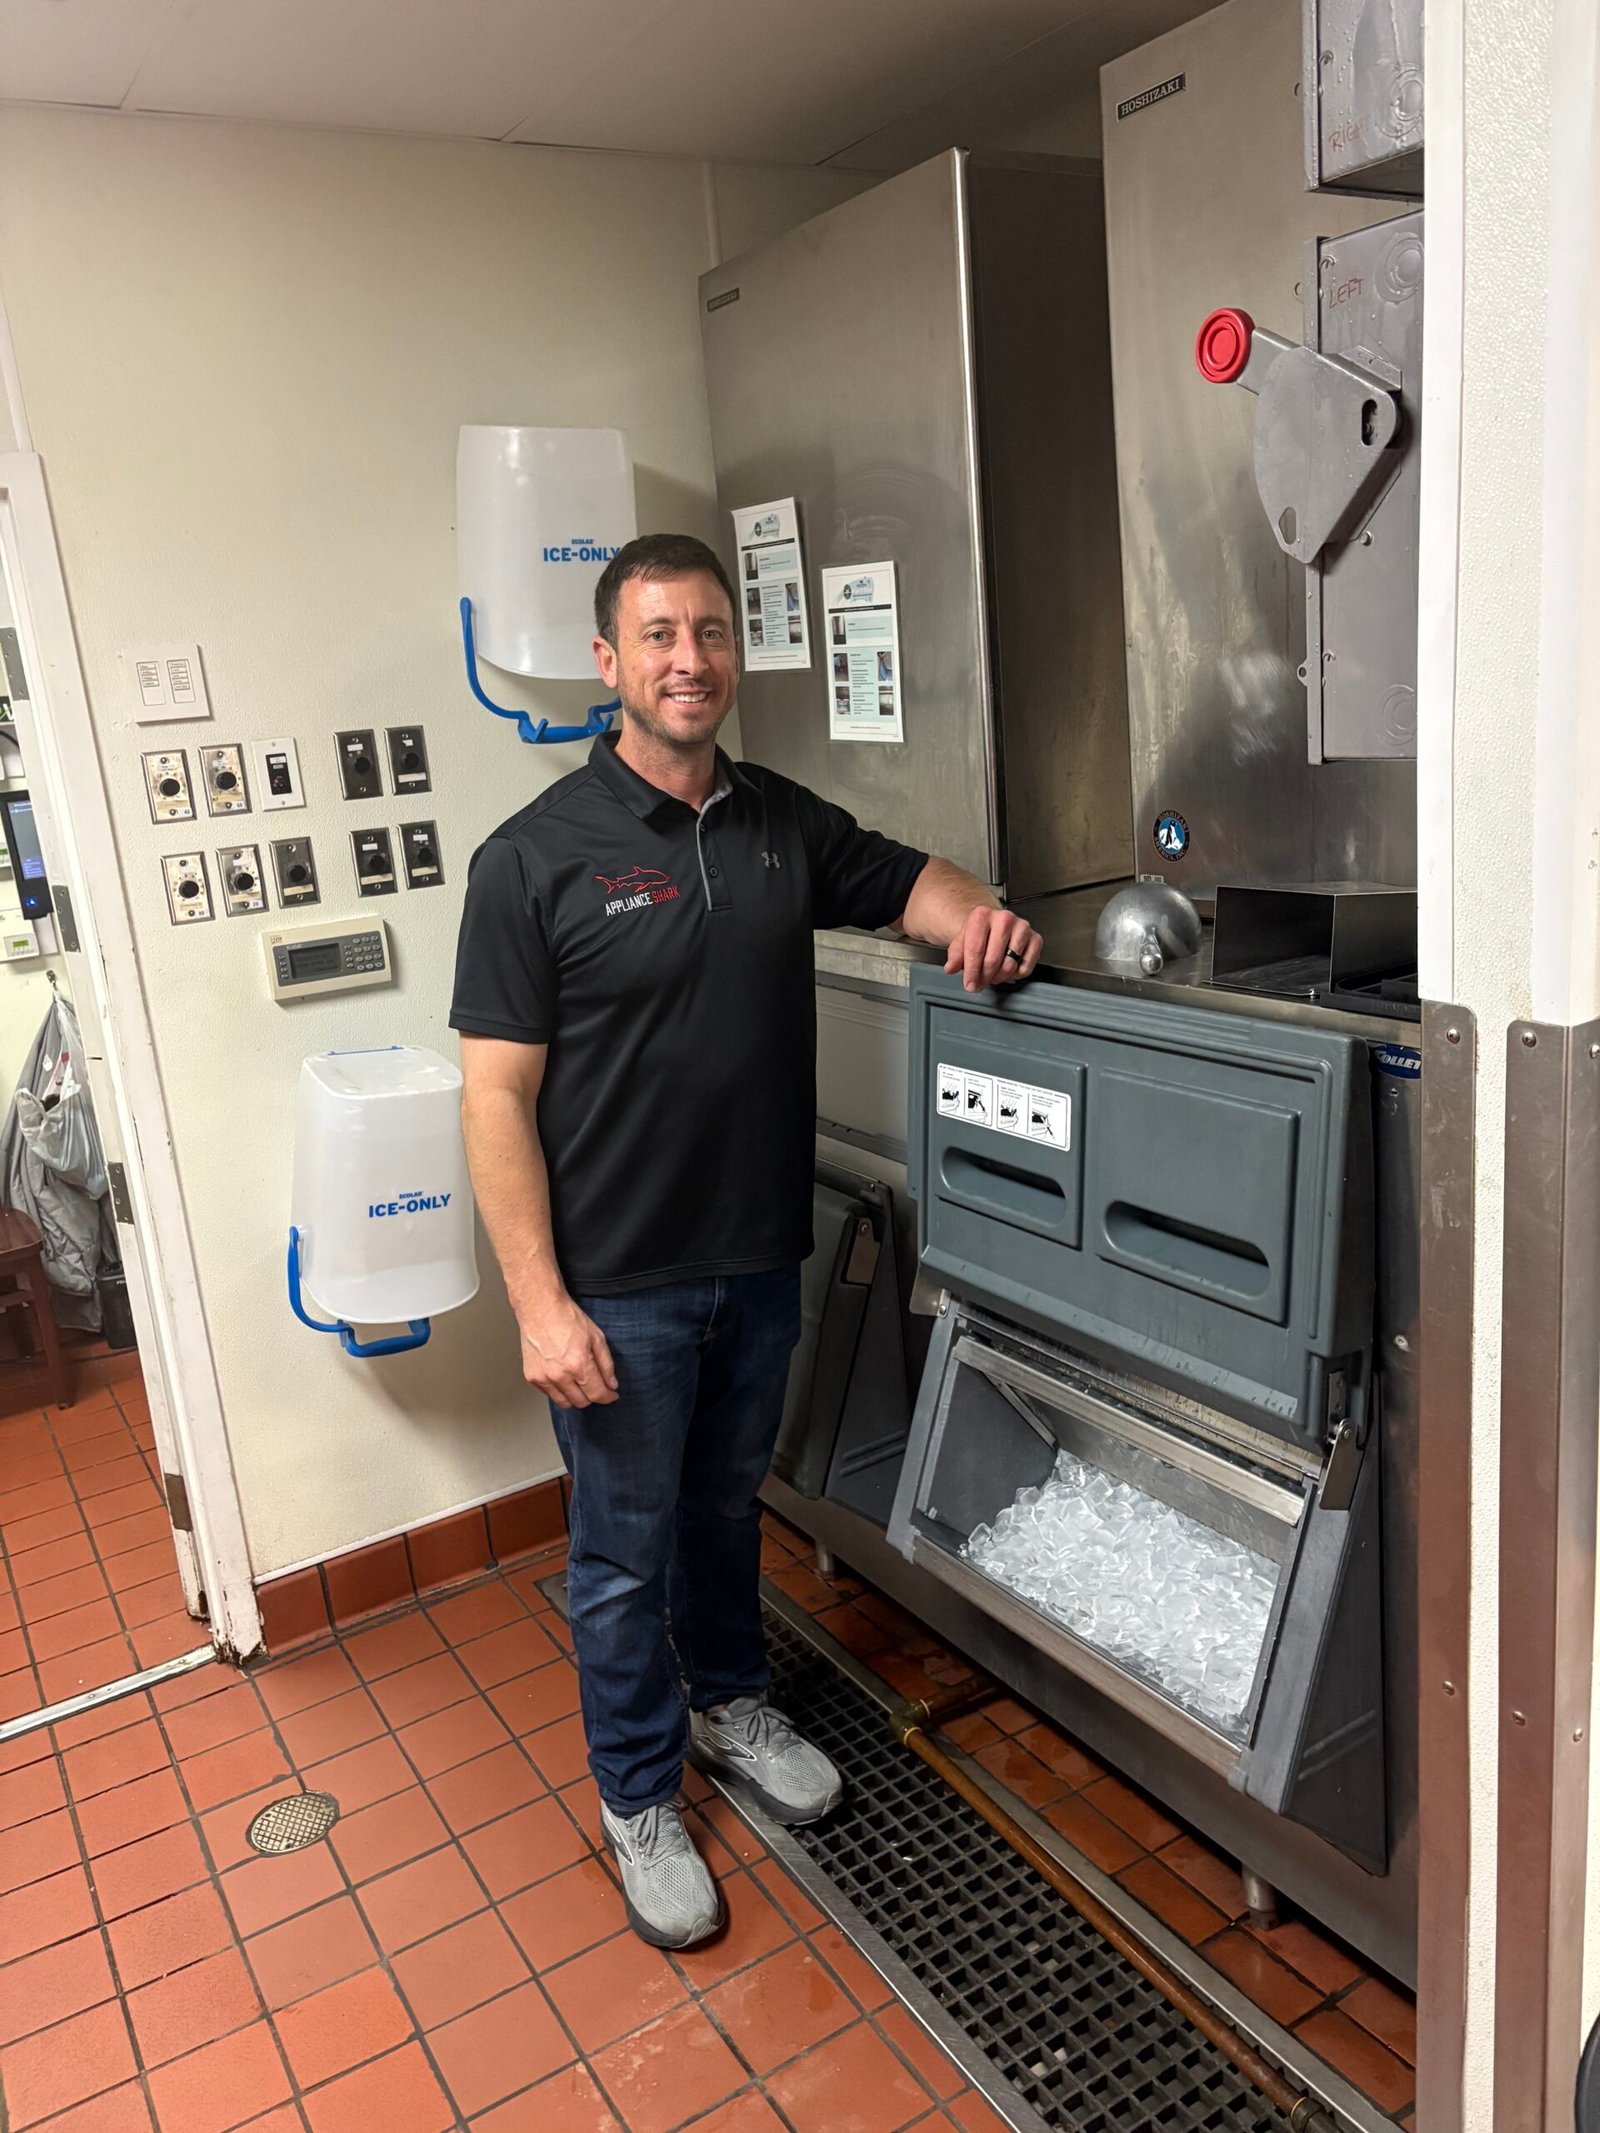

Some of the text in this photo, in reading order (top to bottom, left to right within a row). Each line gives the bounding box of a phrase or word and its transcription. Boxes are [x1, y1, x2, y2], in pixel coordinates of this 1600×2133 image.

[1120, 78, 1181, 116] HOSHIZAKI
[1328, 278, 1364, 310] LEFT
[543, 547, 620, 562] ICE-ONLY
[605, 886, 680, 917] APPLIANCE SHARK
[369, 1193, 451, 1218] ICE-ONLY
[399, 1191, 423, 1199] ECOLAB
